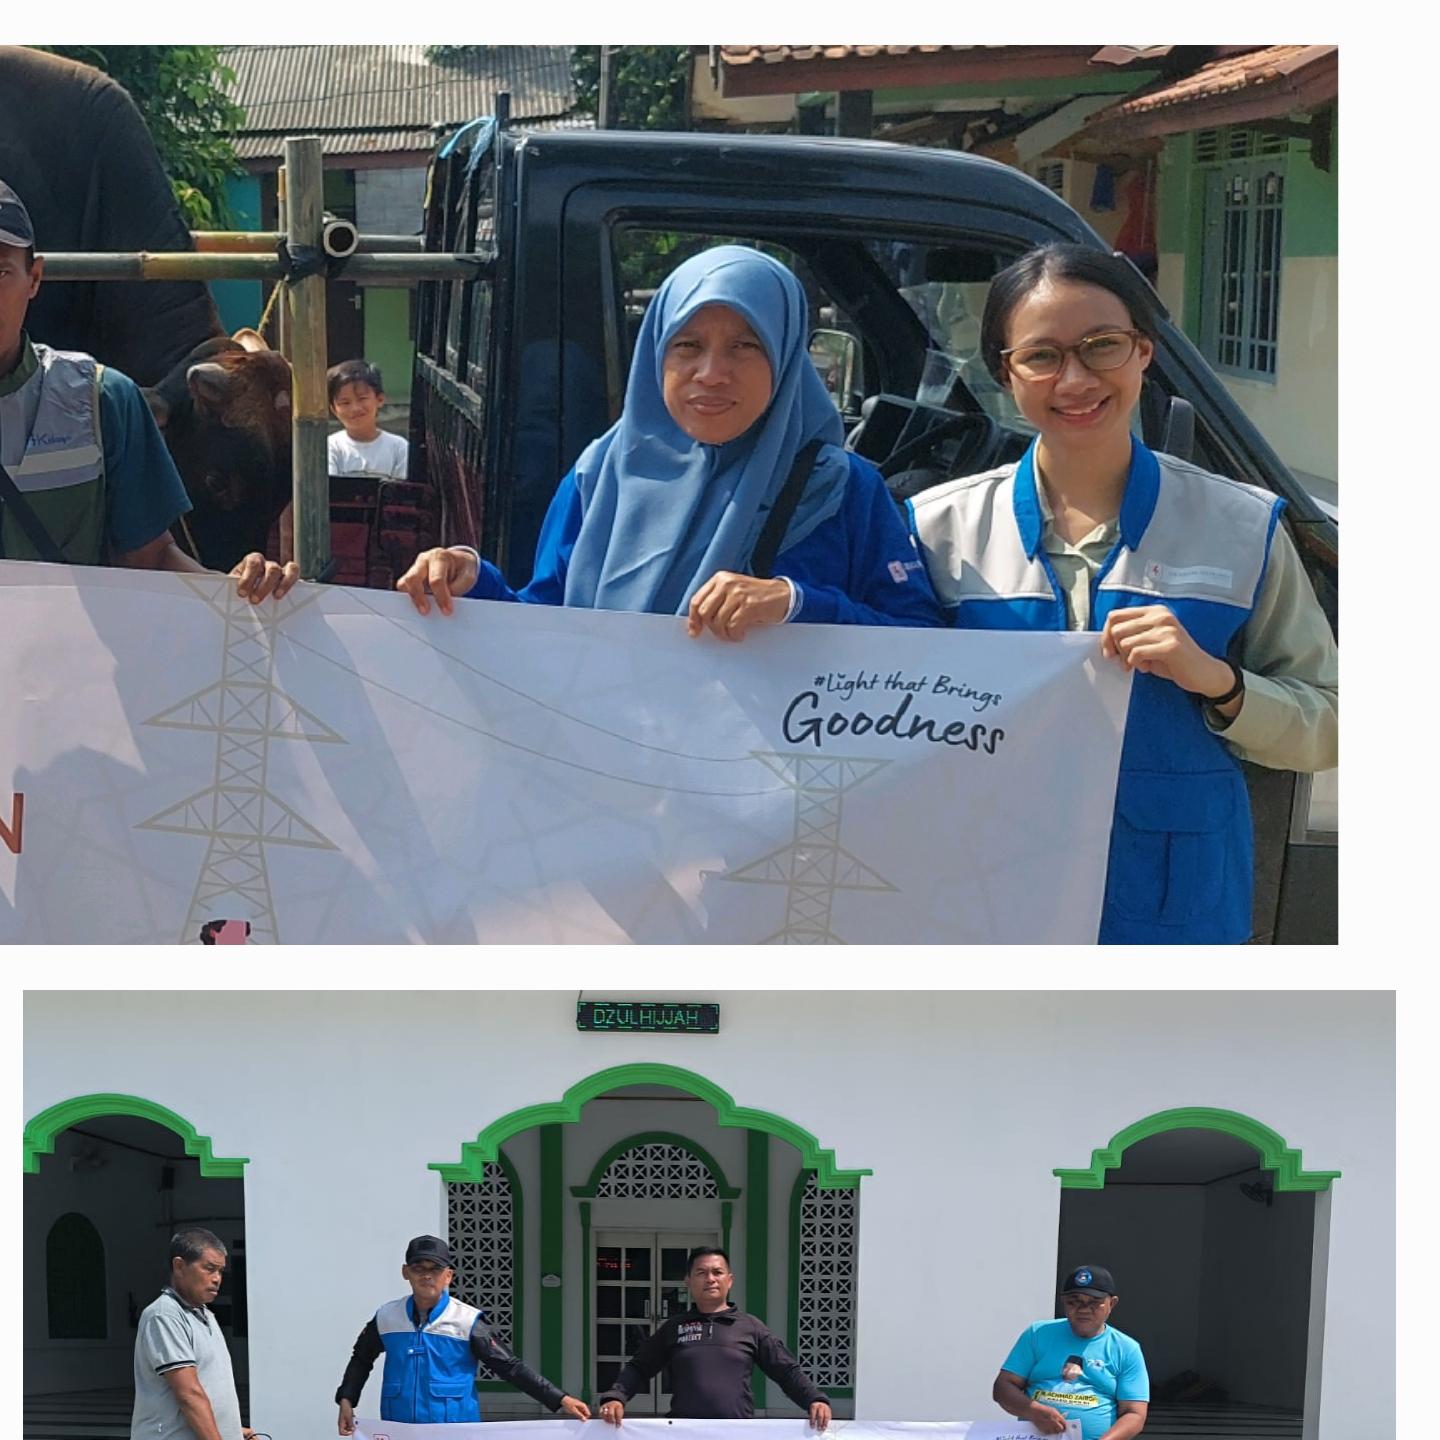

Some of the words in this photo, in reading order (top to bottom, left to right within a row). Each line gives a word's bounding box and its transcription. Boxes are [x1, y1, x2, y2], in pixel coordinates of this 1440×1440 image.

[813, 670, 880, 701] #Light
[884, 671, 928, 692] that
[932, 675, 1002, 712] Brings
[782, 690, 1004, 755] Goodness
[593, 1009, 698, 1025] DZULHIJJAH
